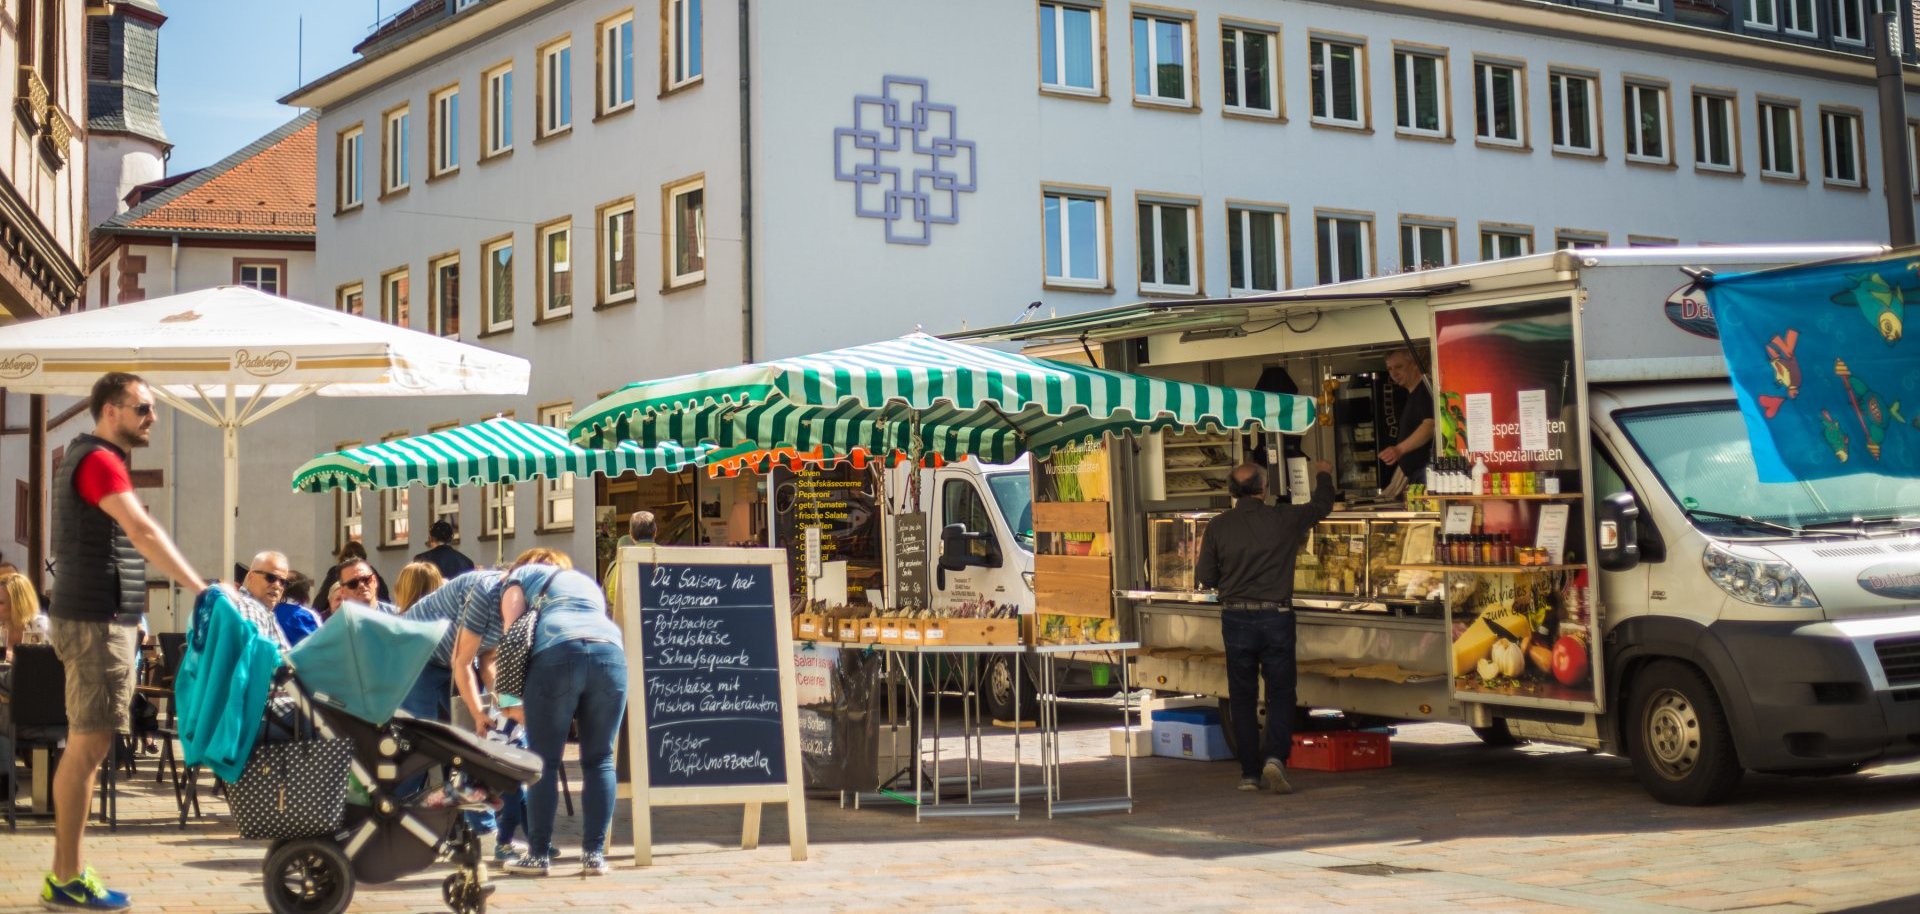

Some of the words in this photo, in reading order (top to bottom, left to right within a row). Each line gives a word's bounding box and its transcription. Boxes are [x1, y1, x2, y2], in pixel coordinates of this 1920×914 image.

[0, 357, 36, 374] deberger
[234, 348, 289, 371] Radeberger
[798, 480, 862, 488] Schafskäsecreme
[798, 490, 831, 499] Peperoni
[799, 511, 823, 519] frische
[824, 511, 848, 519] Salate
[816, 501, 847, 509] Tomaten
[678, 567, 727, 590] Saison
[731, 572, 756, 590] hat
[659, 590, 719, 614] begonnen
[653, 630, 731, 648] Schafskäse
[659, 647, 750, 673] Schafsquark
[647, 676, 713, 697] Frischkäse
[717, 675, 741, 692] mit
[653, 697, 695, 719] frischen
[660, 732, 711, 758] frischer
[668, 749, 772, 778] Büffelmozzarella
